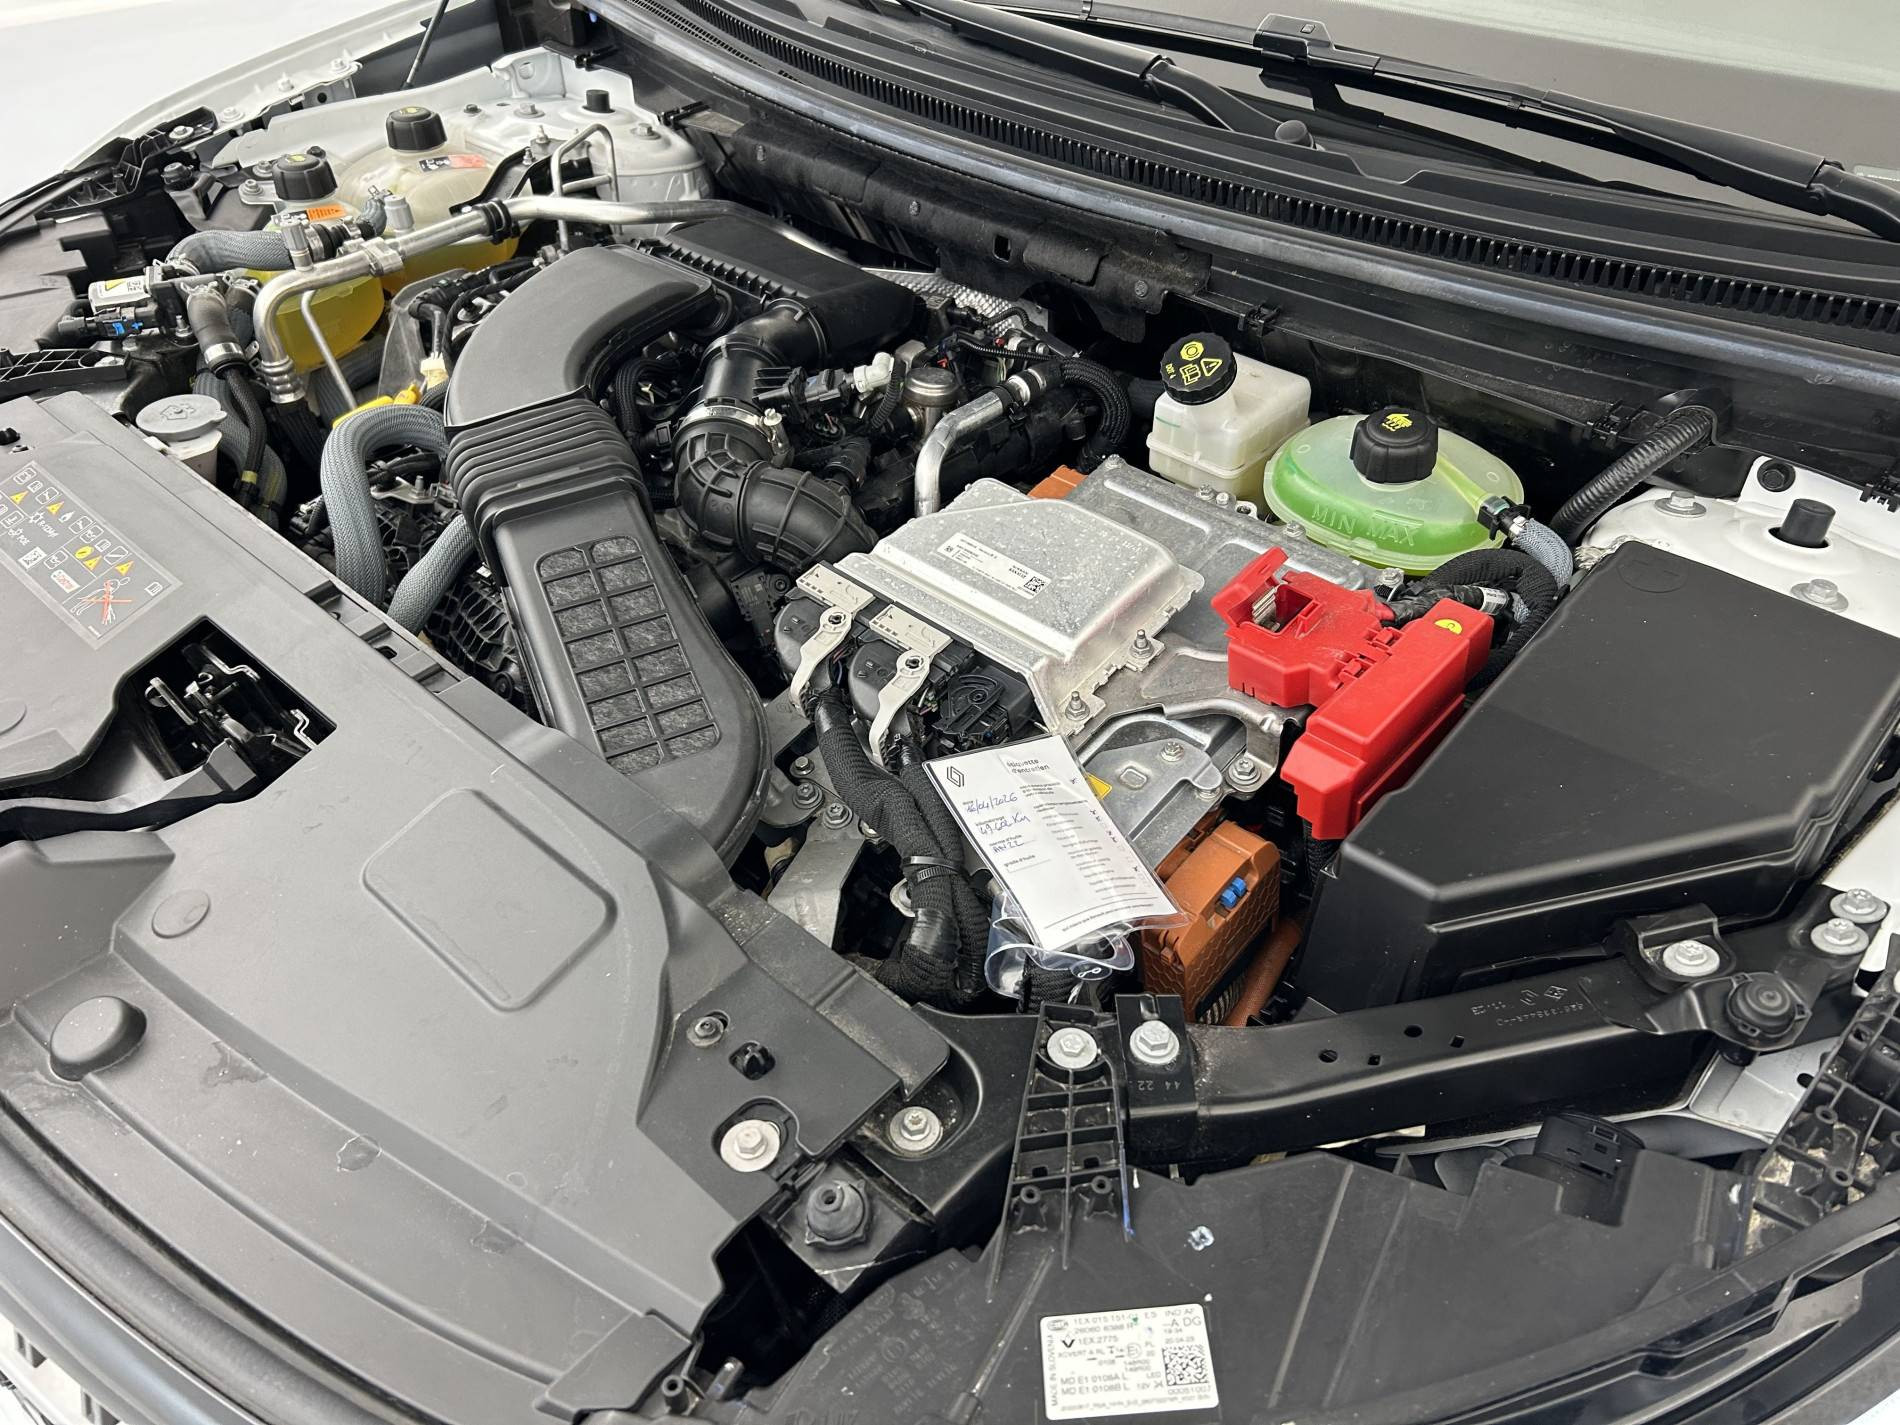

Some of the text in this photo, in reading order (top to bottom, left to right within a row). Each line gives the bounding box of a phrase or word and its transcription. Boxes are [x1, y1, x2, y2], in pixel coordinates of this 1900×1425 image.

[1311, 503, 1419, 547] MIN MAX
[1183, 1316, 1202, 1327] DG
